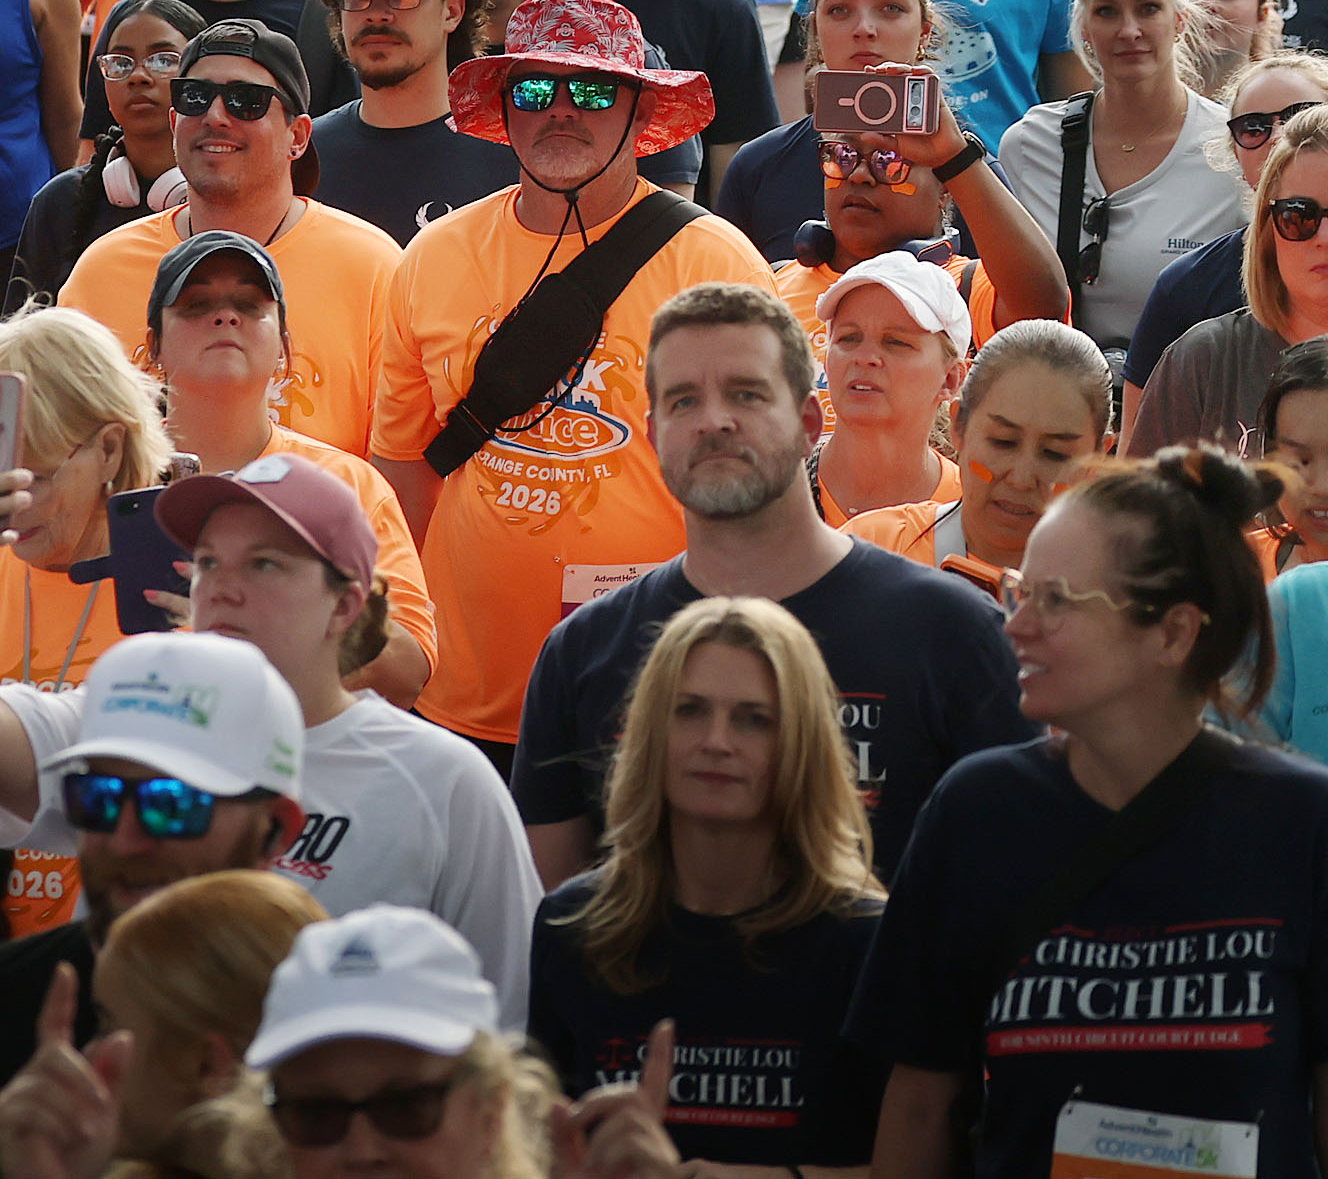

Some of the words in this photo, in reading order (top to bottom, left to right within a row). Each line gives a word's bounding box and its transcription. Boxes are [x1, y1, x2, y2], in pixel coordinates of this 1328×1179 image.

[1167, 237, 1205, 250] Hilton
[592, 463, 613, 481] FL
[496, 481, 561, 516] 2026
[593, 572, 640, 584] AdventHea
[840, 703, 882, 730] OU
[7, 870, 64, 899] 026
[1035, 934, 1197, 966] CHRISTIE
[1207, 927, 1278, 961] LOU
[984, 969, 1276, 1024] MITCHELL
[637, 1046, 745, 1071] CRISTIE
[751, 1047, 800, 1072] LOU
